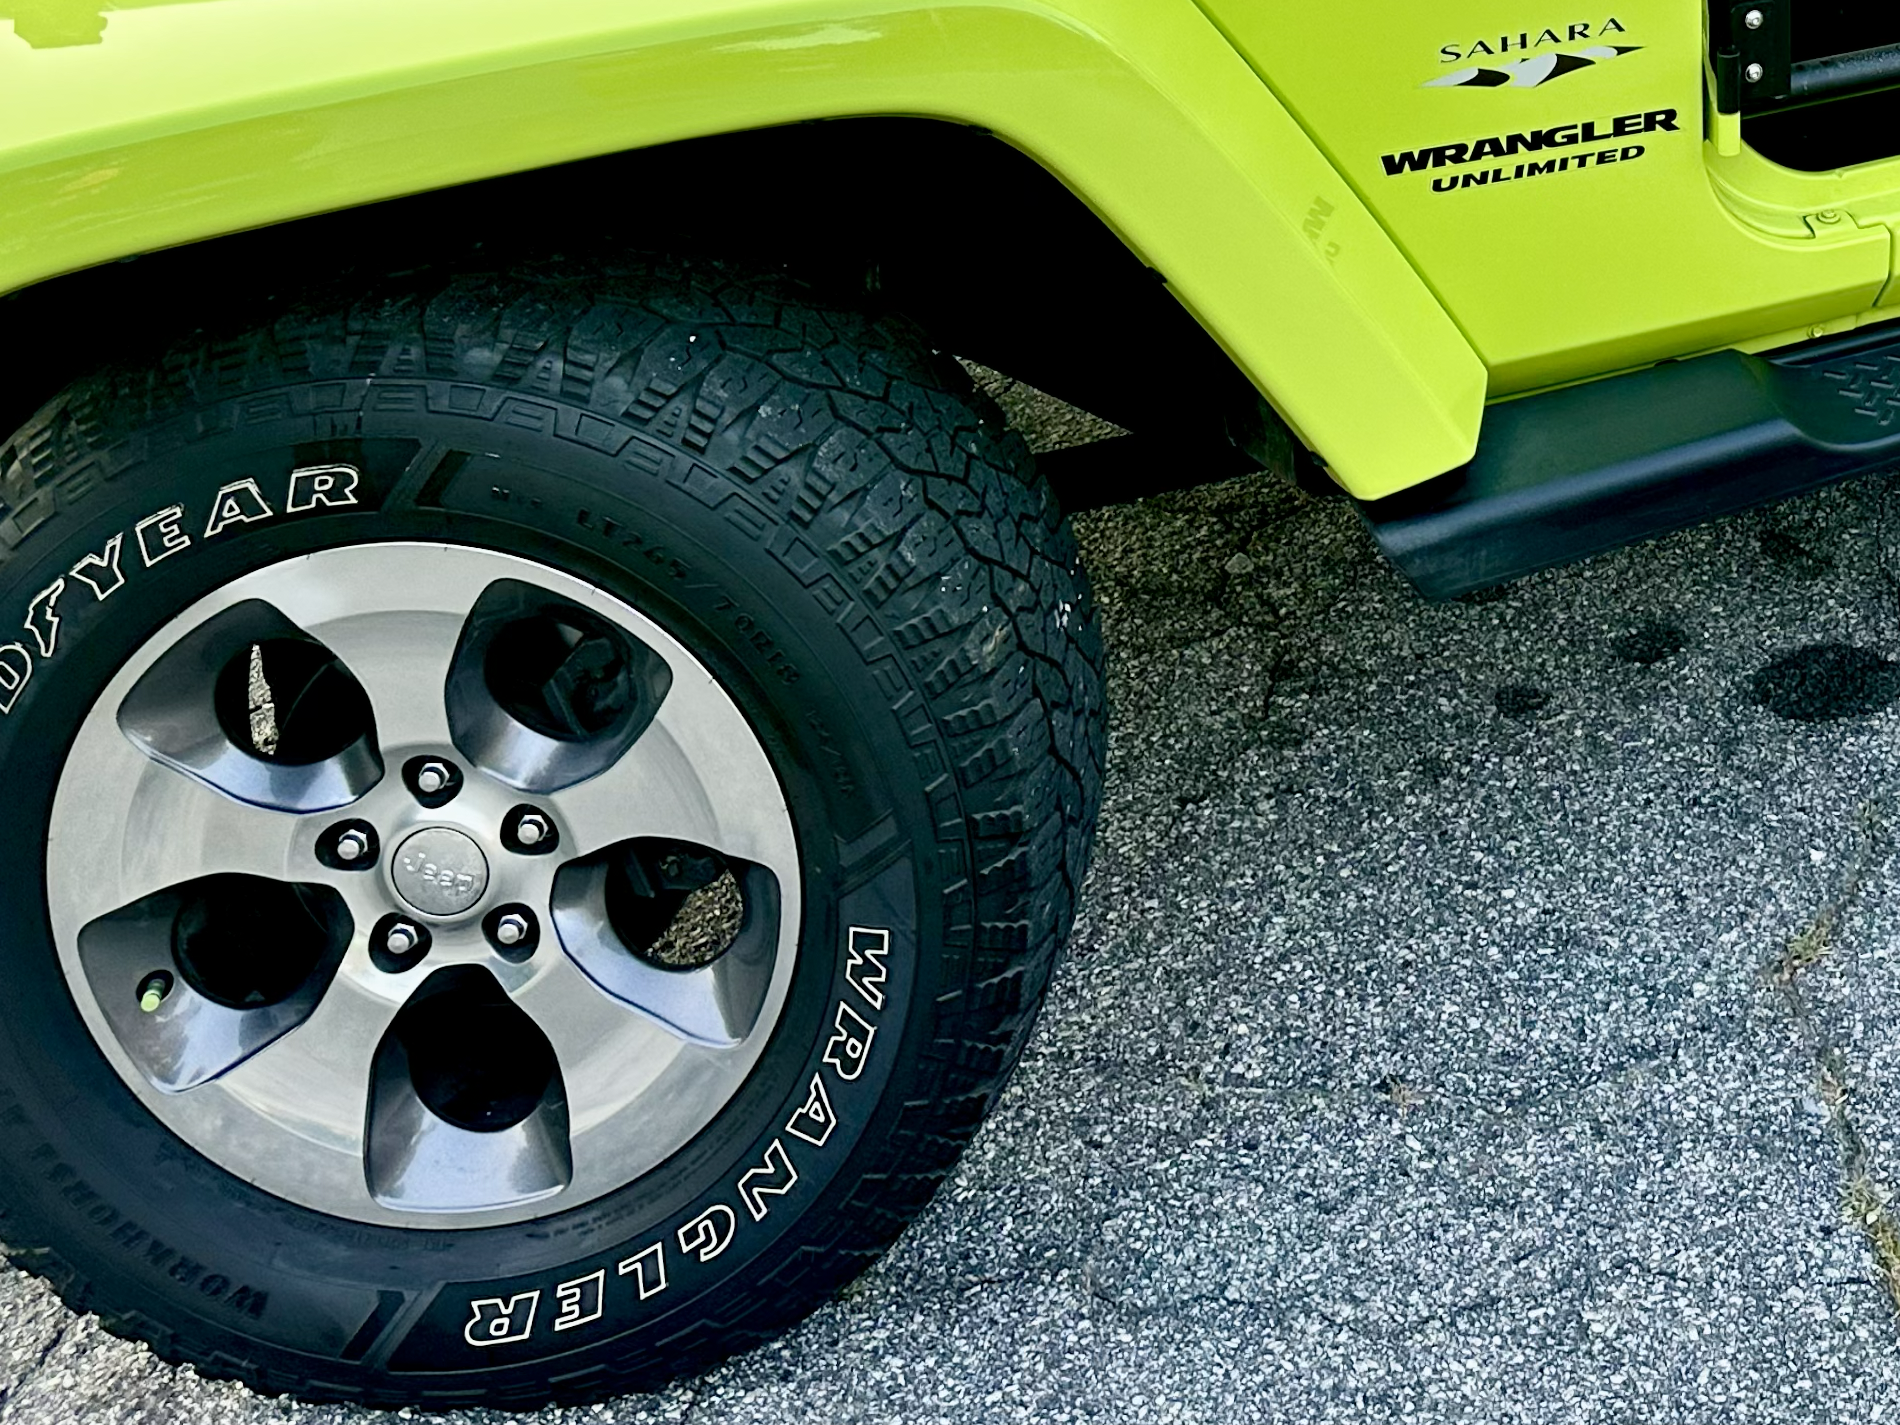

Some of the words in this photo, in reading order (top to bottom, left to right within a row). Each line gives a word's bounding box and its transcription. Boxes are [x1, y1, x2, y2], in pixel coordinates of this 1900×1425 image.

[1440, 17, 1627, 64] SAHARA
[1380, 108, 1682, 177] WRANGLER
[1431, 145, 1646, 193] UNLIMITED
[463, 925, 890, 1347] WRANGLER
